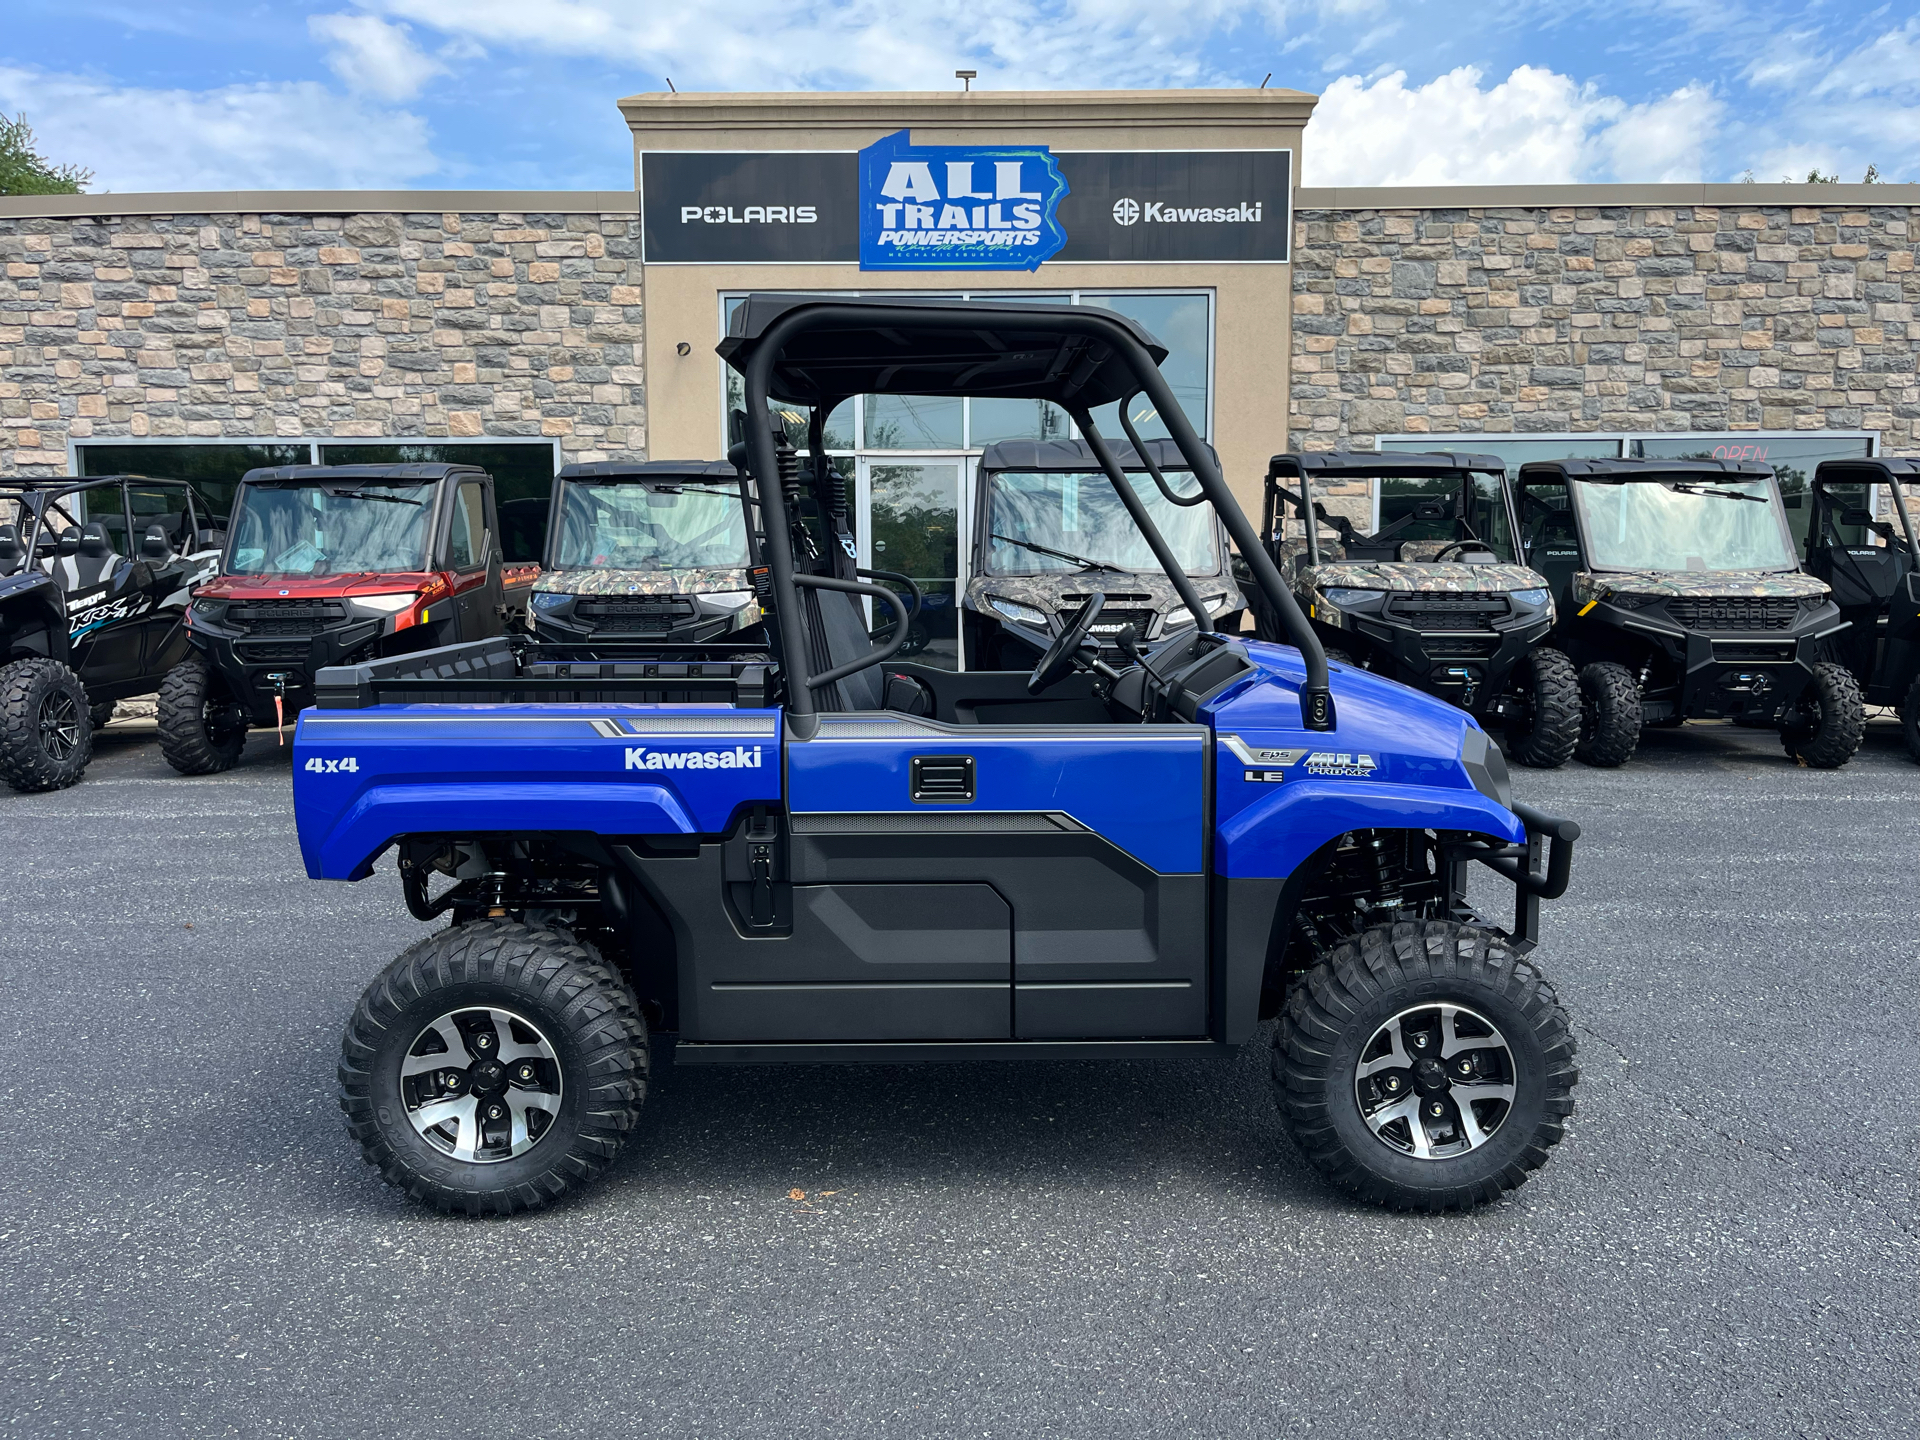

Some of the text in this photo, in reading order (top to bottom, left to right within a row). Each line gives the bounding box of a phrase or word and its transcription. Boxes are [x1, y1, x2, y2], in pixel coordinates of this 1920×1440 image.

[880, 161, 1042, 203] ALL
[681, 206, 818, 223] POLARIS
[876, 202, 1042, 229] TRAILS
[1144, 201, 1262, 222] Kawasaki
[877, 230, 1041, 246] POWERSPORTS
[1711, 445, 1769, 462] OPEN
[258, 609, 311, 617] POLARIS
[607, 605, 660, 613] POLARIS
[1425, 603, 1478, 611] POLARIS
[1698, 607, 1779, 618] POLARIS
[304, 757, 360, 773] 4x4
[625, 746, 761, 770] Kawasaki
[1303, 752, 1377, 770] MULE
[1245, 771, 1283, 782] LE
